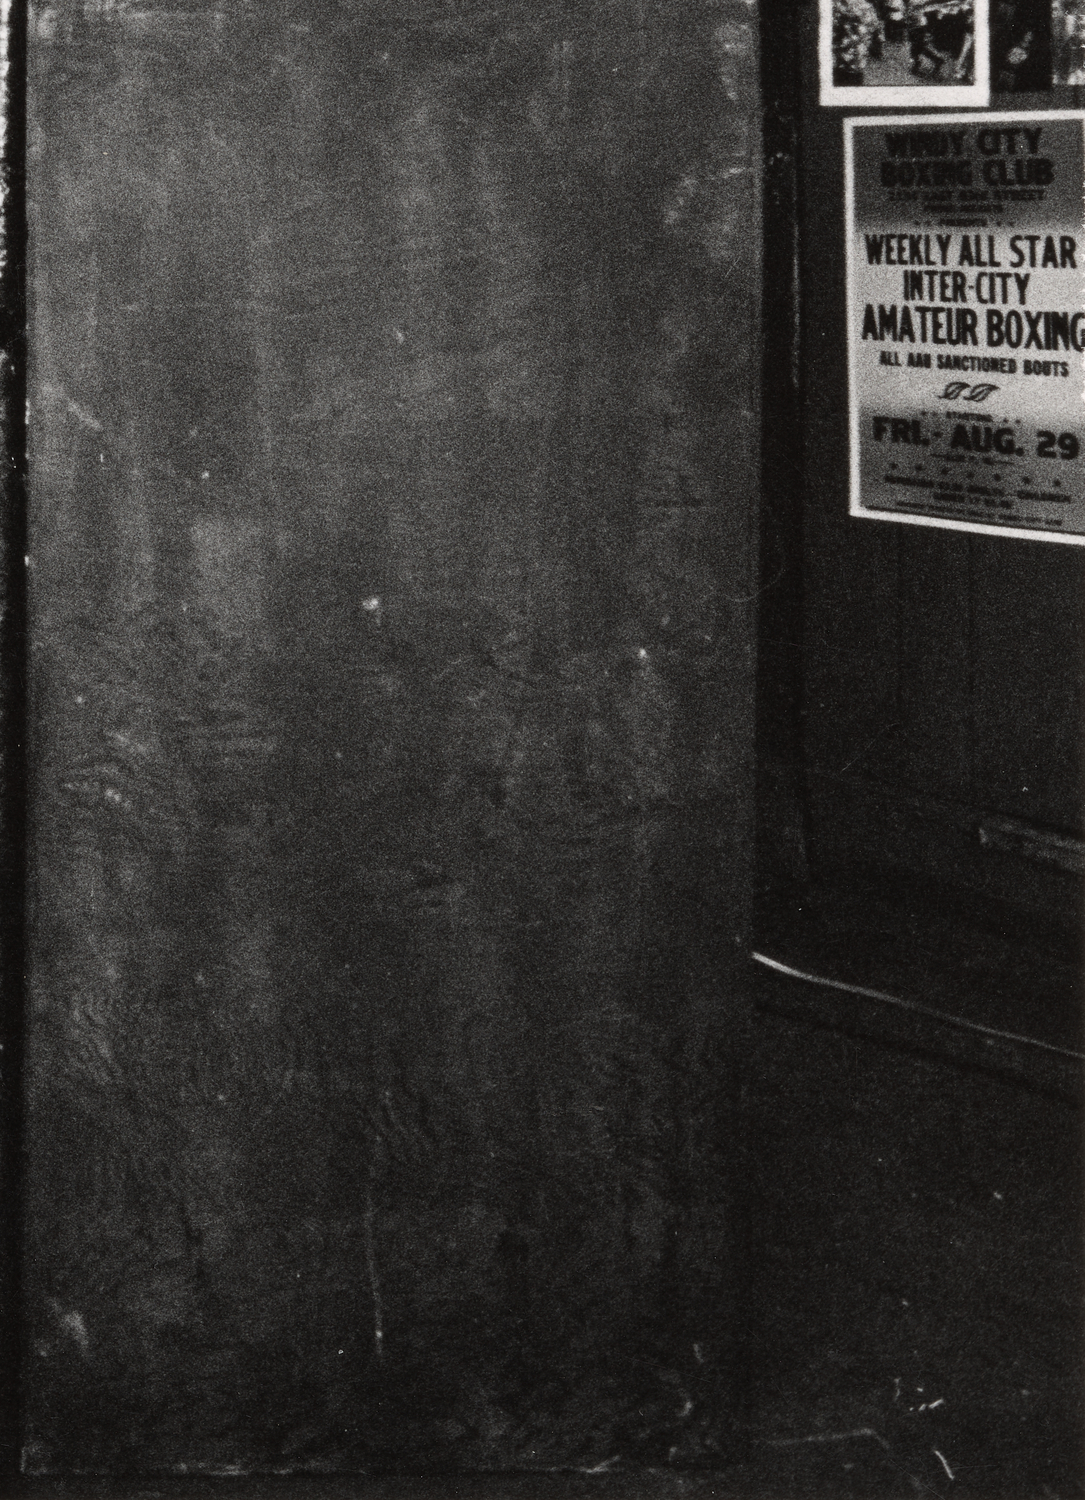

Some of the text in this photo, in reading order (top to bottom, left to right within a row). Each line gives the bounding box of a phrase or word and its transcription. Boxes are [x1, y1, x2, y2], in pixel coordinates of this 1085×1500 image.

[885, 128, 1043, 158] WINDY CITY
[881, 159, 1054, 186] BOXING CLUB
[865, 234, 1077, 269] WEEKLY ALL STAR
[903, 270, 1030, 305] INTER-CITY
[862, 304, 1085, 352] AMATEUR BOXING
[880, 351, 902, 366] ALL
[937, 354, 1017, 374] SANCTIONED
[1023, 359, 1069, 377] BOUTS
[951, 424, 1024, 456] AUG.
[1036, 430, 1080, 460] 29
